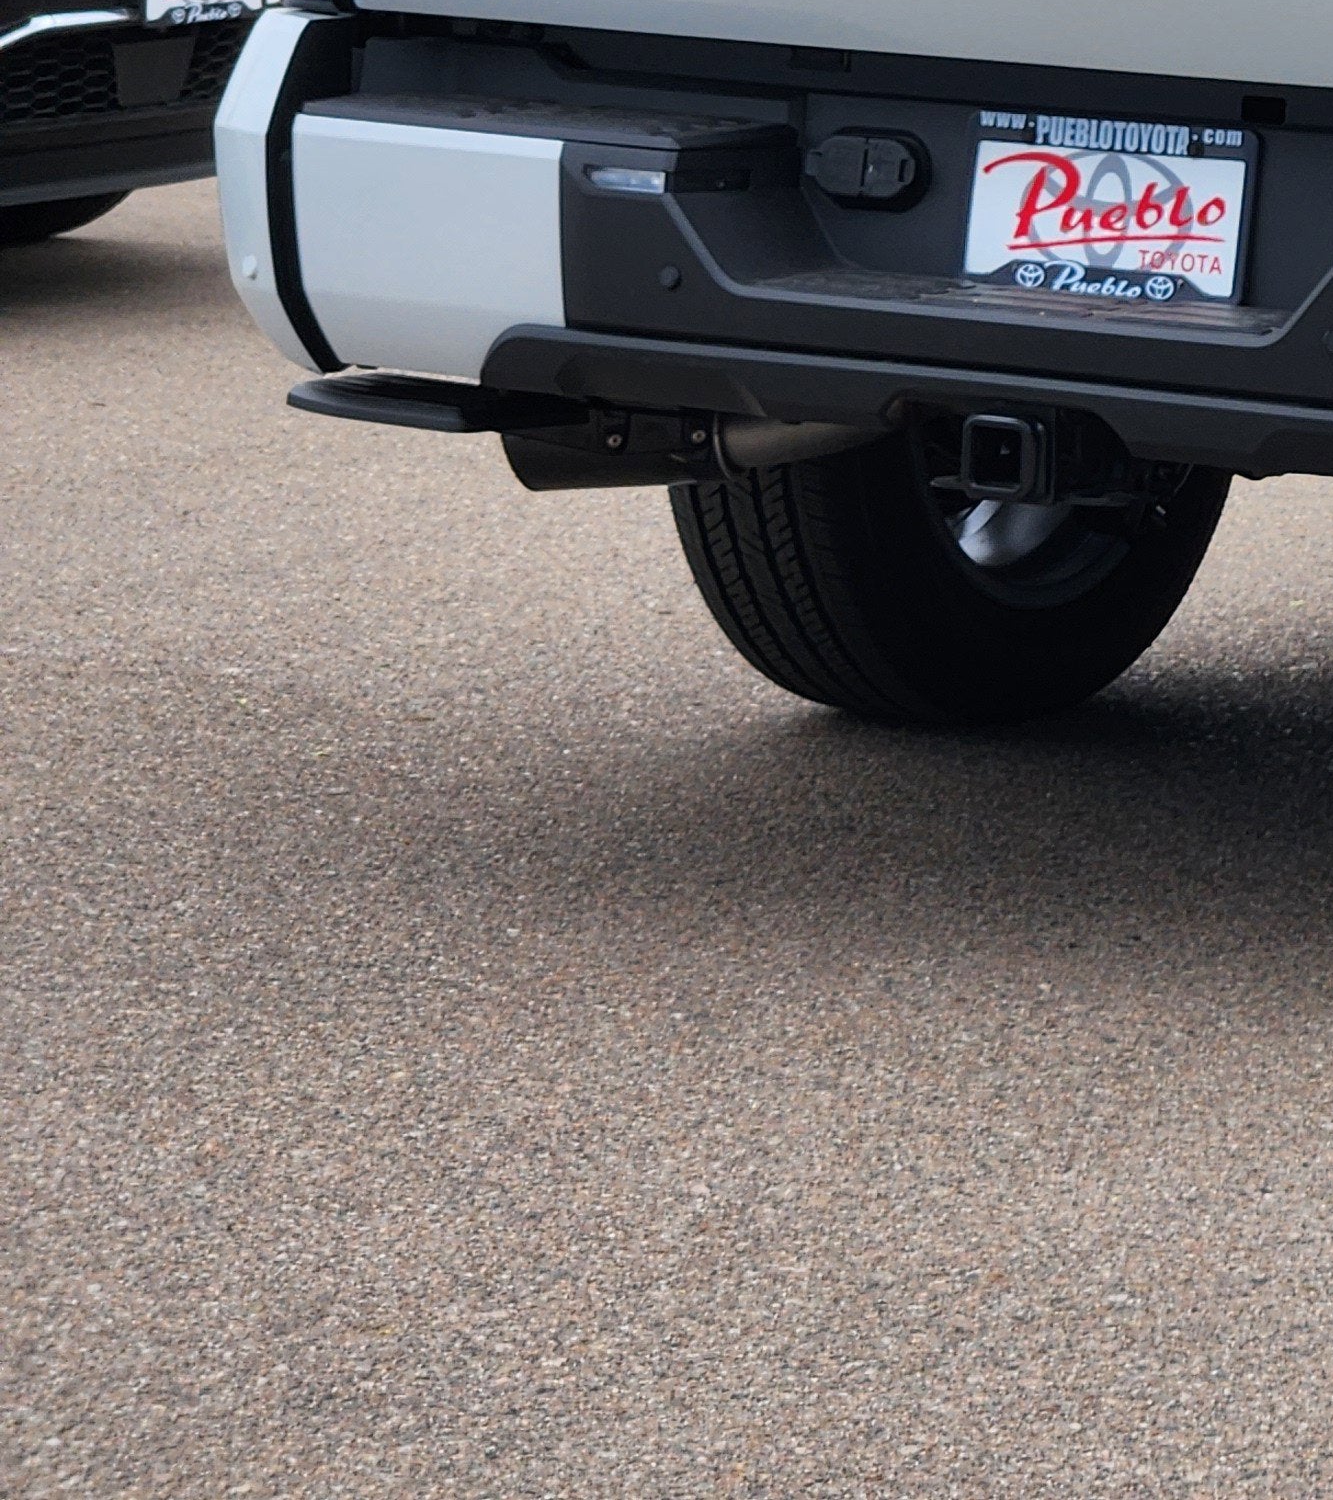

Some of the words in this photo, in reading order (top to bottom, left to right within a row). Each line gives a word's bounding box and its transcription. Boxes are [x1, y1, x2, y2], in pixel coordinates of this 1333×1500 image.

[982, 151, 1226, 239] Pueblo
[1044, 259, 1142, 298] Pueblo
[1138, 249, 1222, 275] TOYOTA
